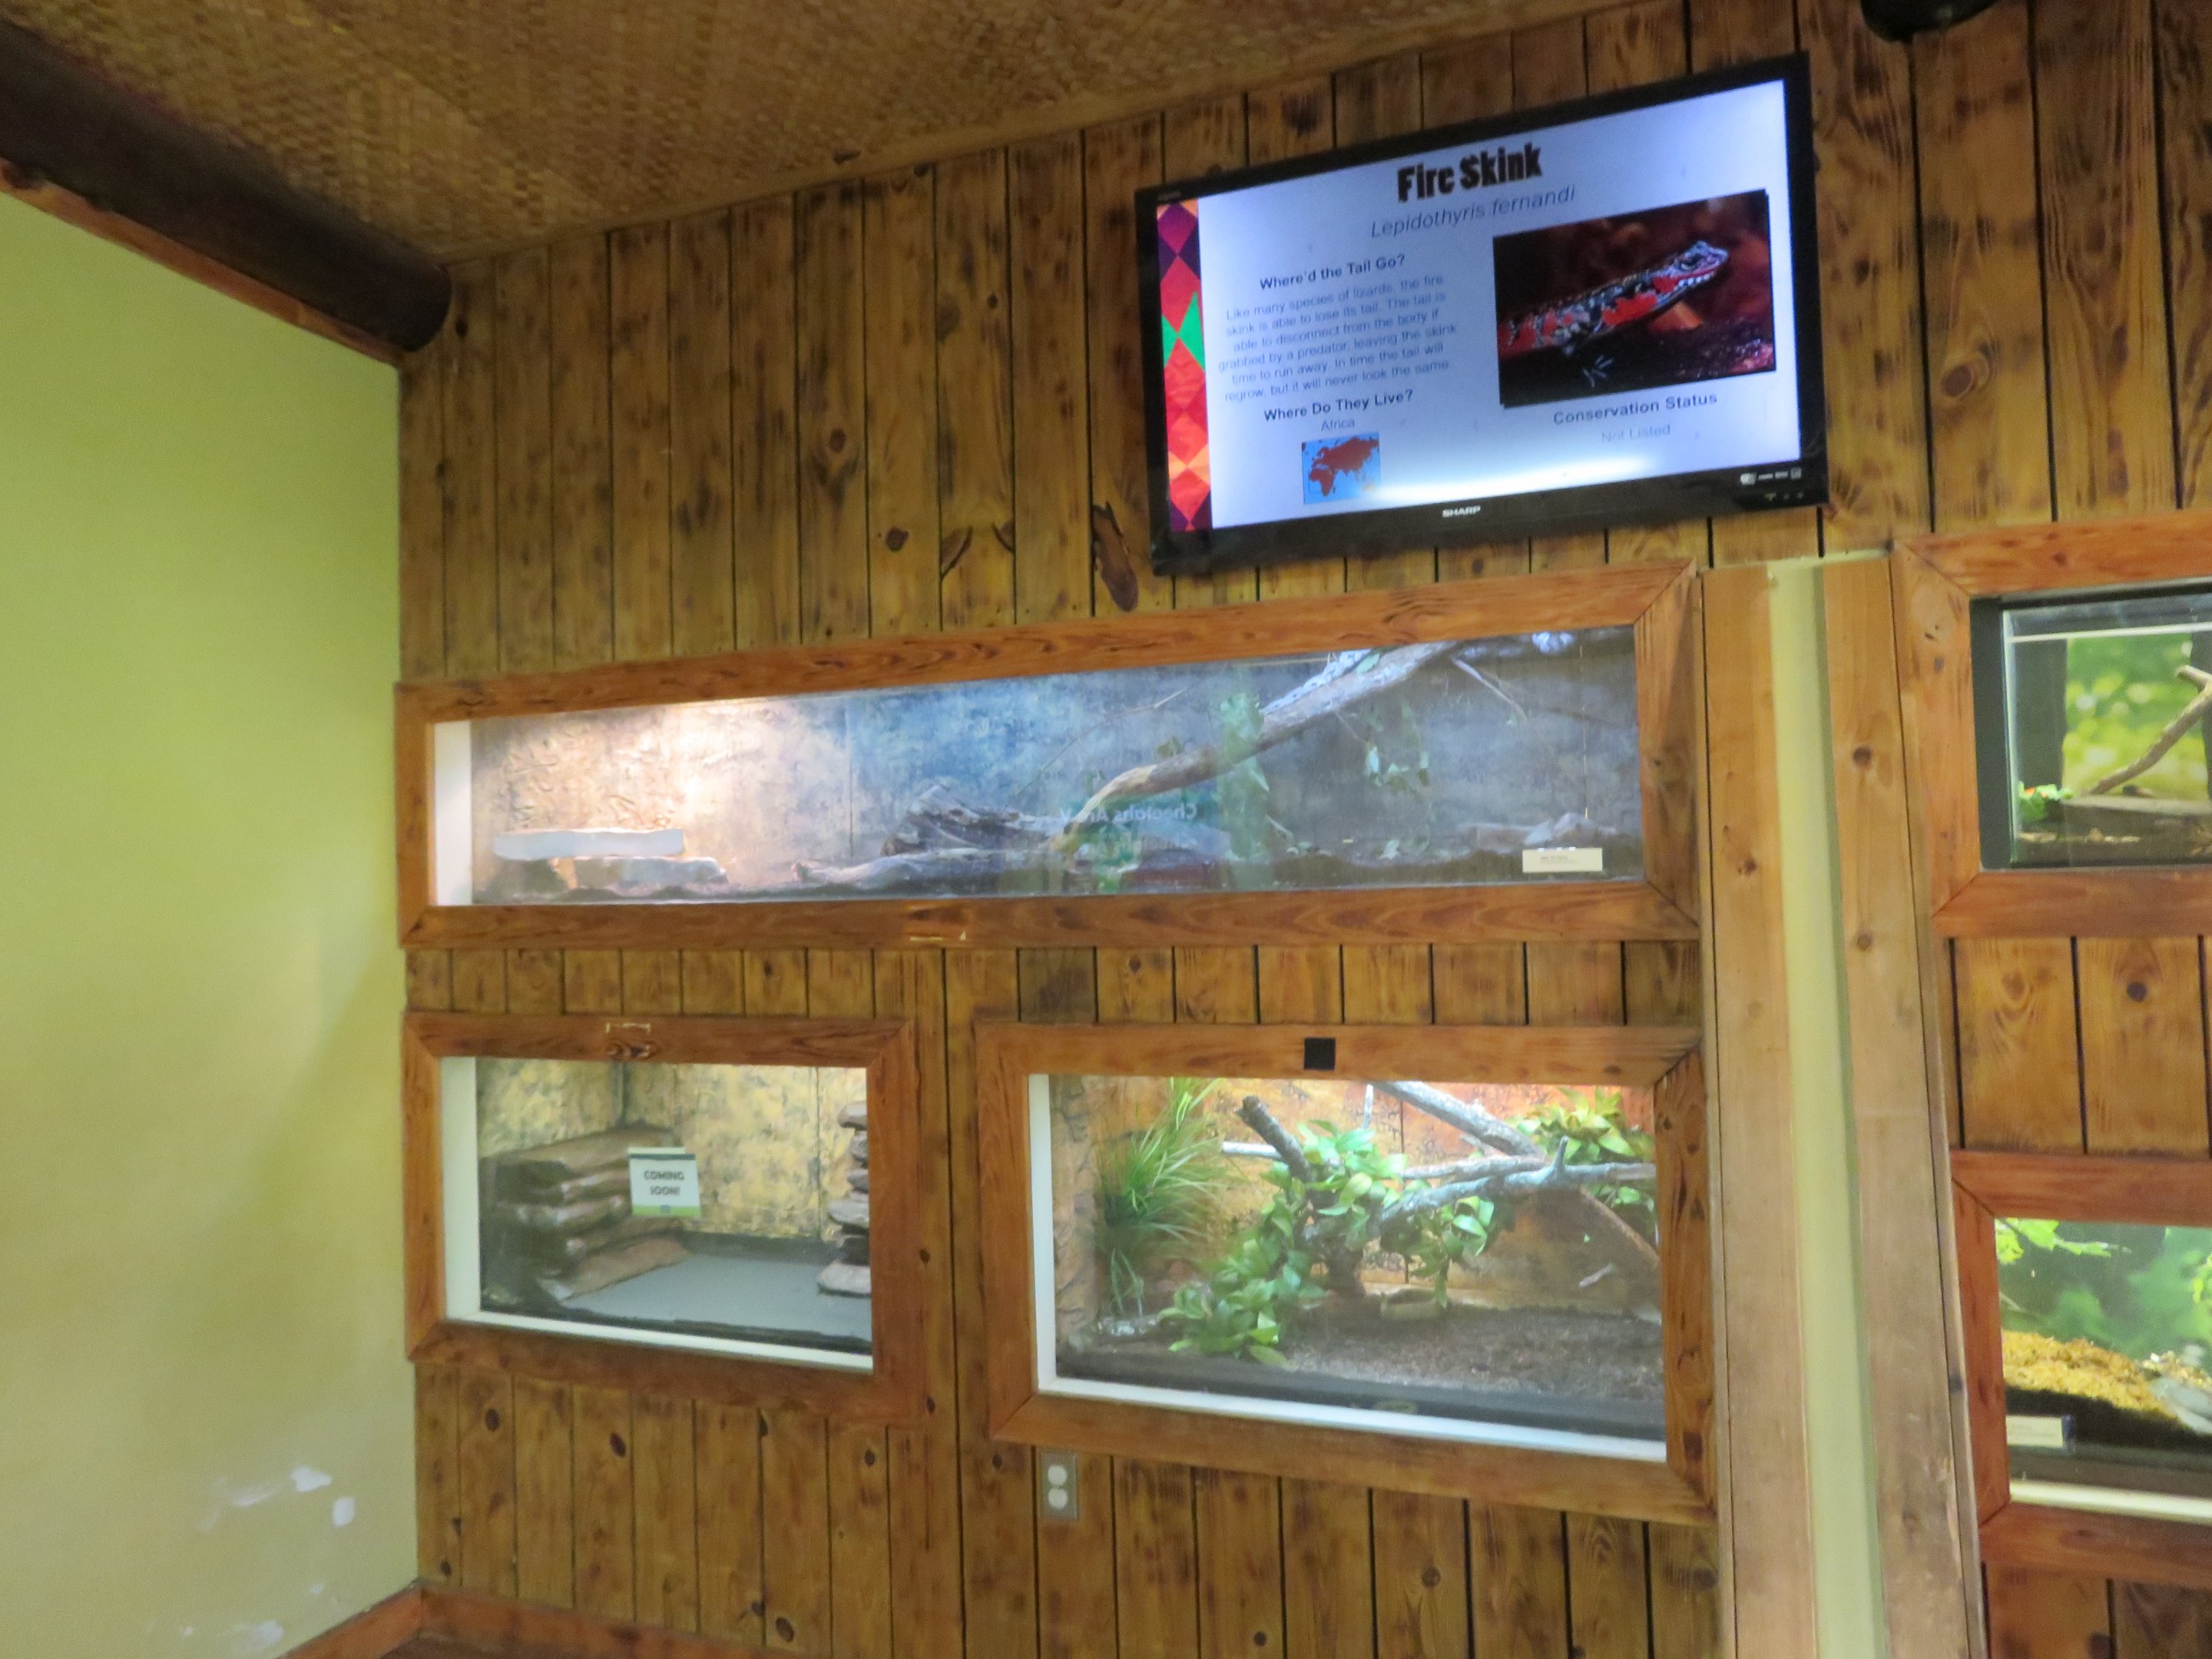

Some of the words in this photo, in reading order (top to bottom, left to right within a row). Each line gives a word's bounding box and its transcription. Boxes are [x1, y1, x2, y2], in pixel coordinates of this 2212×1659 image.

[1397, 163, 1455, 203] Fire
[1459, 141, 1542, 189] Skink
[1371, 203, 1485, 238] Lepidothyris
[1492, 184, 1575, 215] fernandi
[1260, 270, 1316, 290] Where'd
[1320, 268, 1343, 280] the
[1347, 260, 1371, 275] Tail
[1376, 254, 1405, 270] Go?
[1227, 306, 1250, 320] Like
[1254, 302, 1285, 316] many
[1290, 293, 1333, 311] species
[1338, 290, 1349, 301] of
[1401, 279, 1419, 290] the
[1425, 275, 1444, 286] fire
[1227, 323, 1254, 337] skink
[1260, 321, 1270, 332] is
[1272, 317, 1296, 329] able
[1301, 315, 1311, 324] to
[1315, 309, 1339, 323] lose
[1343, 306, 1356, 316] its
[1387, 296, 1409, 310] The
[1414, 292, 1431, 305] tail
[1435, 291, 1445, 303] is
[1218, 353, 1265, 374] grabbed
[1270, 351, 1283, 366] by
[1287, 349, 1293, 359] a
[1354, 333, 1397, 349] leaving
[1402, 329, 1420, 341] the
[1426, 323, 1456, 338] skink
[1233, 338, 1257, 352] able
[1262, 336, 1273, 347] to
[1277, 326, 1340, 345] disconnect
[1344, 322, 1370, 334] from
[1375, 318, 1393, 329] the
[1398, 311, 1427, 327] body
[1432, 309, 1439, 320] if
[1232, 372, 1256, 385] time
[1260, 370, 1271, 381] to
[1275, 366, 1293, 378] run
[1334, 357, 1345, 368] In
[1349, 353, 1375, 366] time
[1379, 349, 1399, 361] the
[1402, 345, 1420, 357] tail
[1425, 342, 1444, 356] will
[1270, 382, 1288, 396] but
[1293, 381, 1298, 392] it
[1303, 379, 1321, 391] will
[1325, 373, 1357, 387] never
[1363, 367, 1386, 381] look
[1391, 363, 1411, 376] the
[1264, 404, 1307, 422] Where
[1313, 401, 1330, 415] Do
[1336, 397, 1369, 412] They
[1375, 389, 1413, 406] Live?
[1553, 401, 1660, 424] Conservation
[1665, 392, 1717, 410] Status
[1321, 418, 1355, 431] Africa
[1601, 429, 1624, 444] Not
[1629, 423, 1671, 441] Listed
[1442, 505, 1482, 518] SHARP
[644, 1171, 684, 1181] COMING
